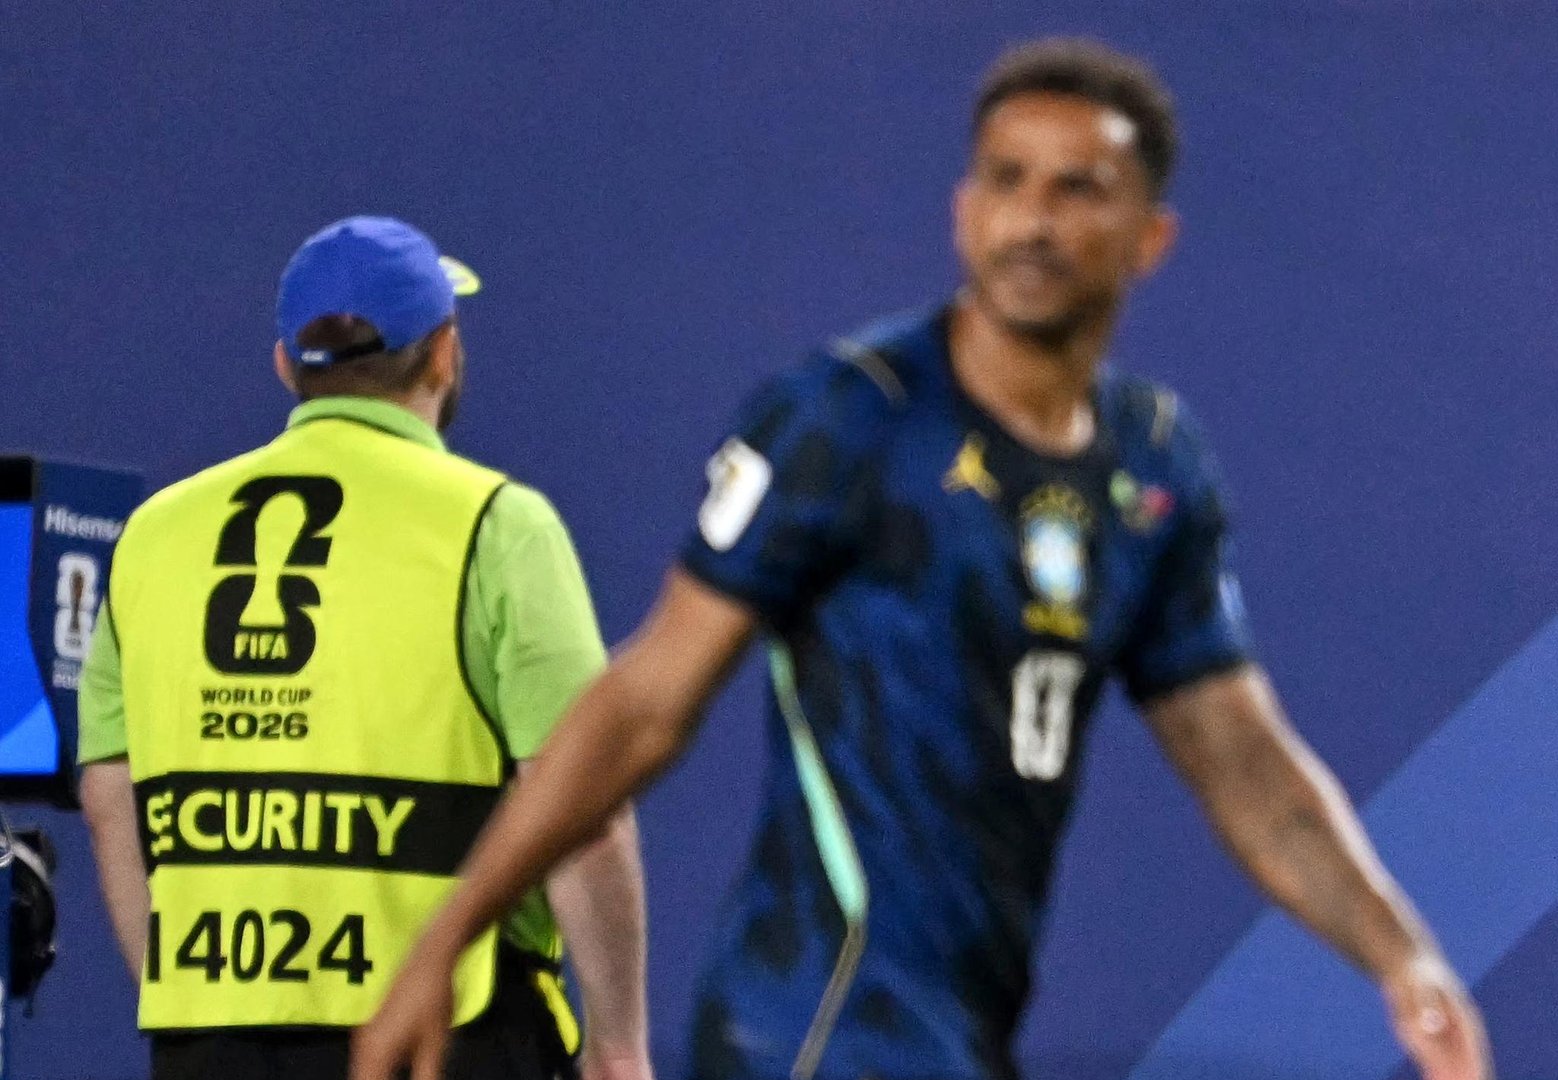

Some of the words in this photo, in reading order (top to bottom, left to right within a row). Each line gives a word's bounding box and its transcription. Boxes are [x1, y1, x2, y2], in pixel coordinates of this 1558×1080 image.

[233, 632, 288, 661] FIFA
[200, 688, 273, 707] WORLD
[277, 688, 313, 707] CUP
[200, 711, 309, 741] 2026
[146, 908, 374, 985] 14024
